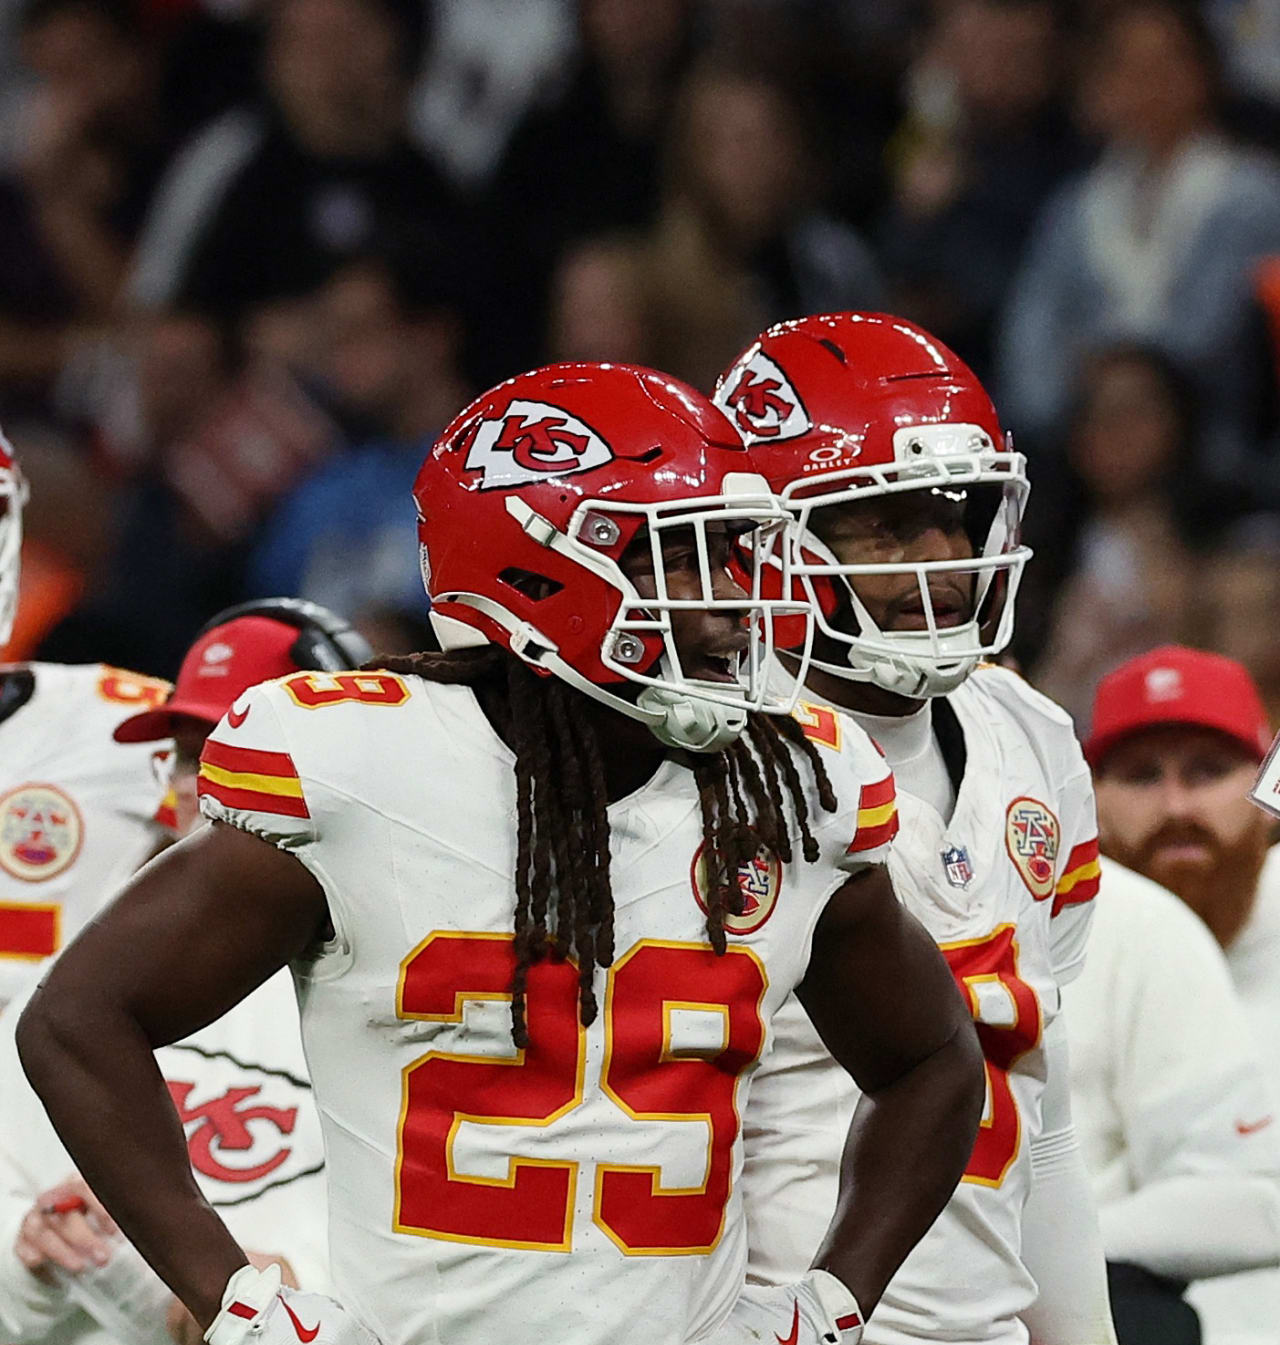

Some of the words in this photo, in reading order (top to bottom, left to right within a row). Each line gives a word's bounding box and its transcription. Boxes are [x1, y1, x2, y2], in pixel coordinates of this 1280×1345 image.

[726, 369, 795, 438] KC
[491, 415, 590, 472] KC
[803, 457, 852, 472] OAKLEY
[392, 931, 767, 1256] 29
[165, 1080, 299, 1183] KC
